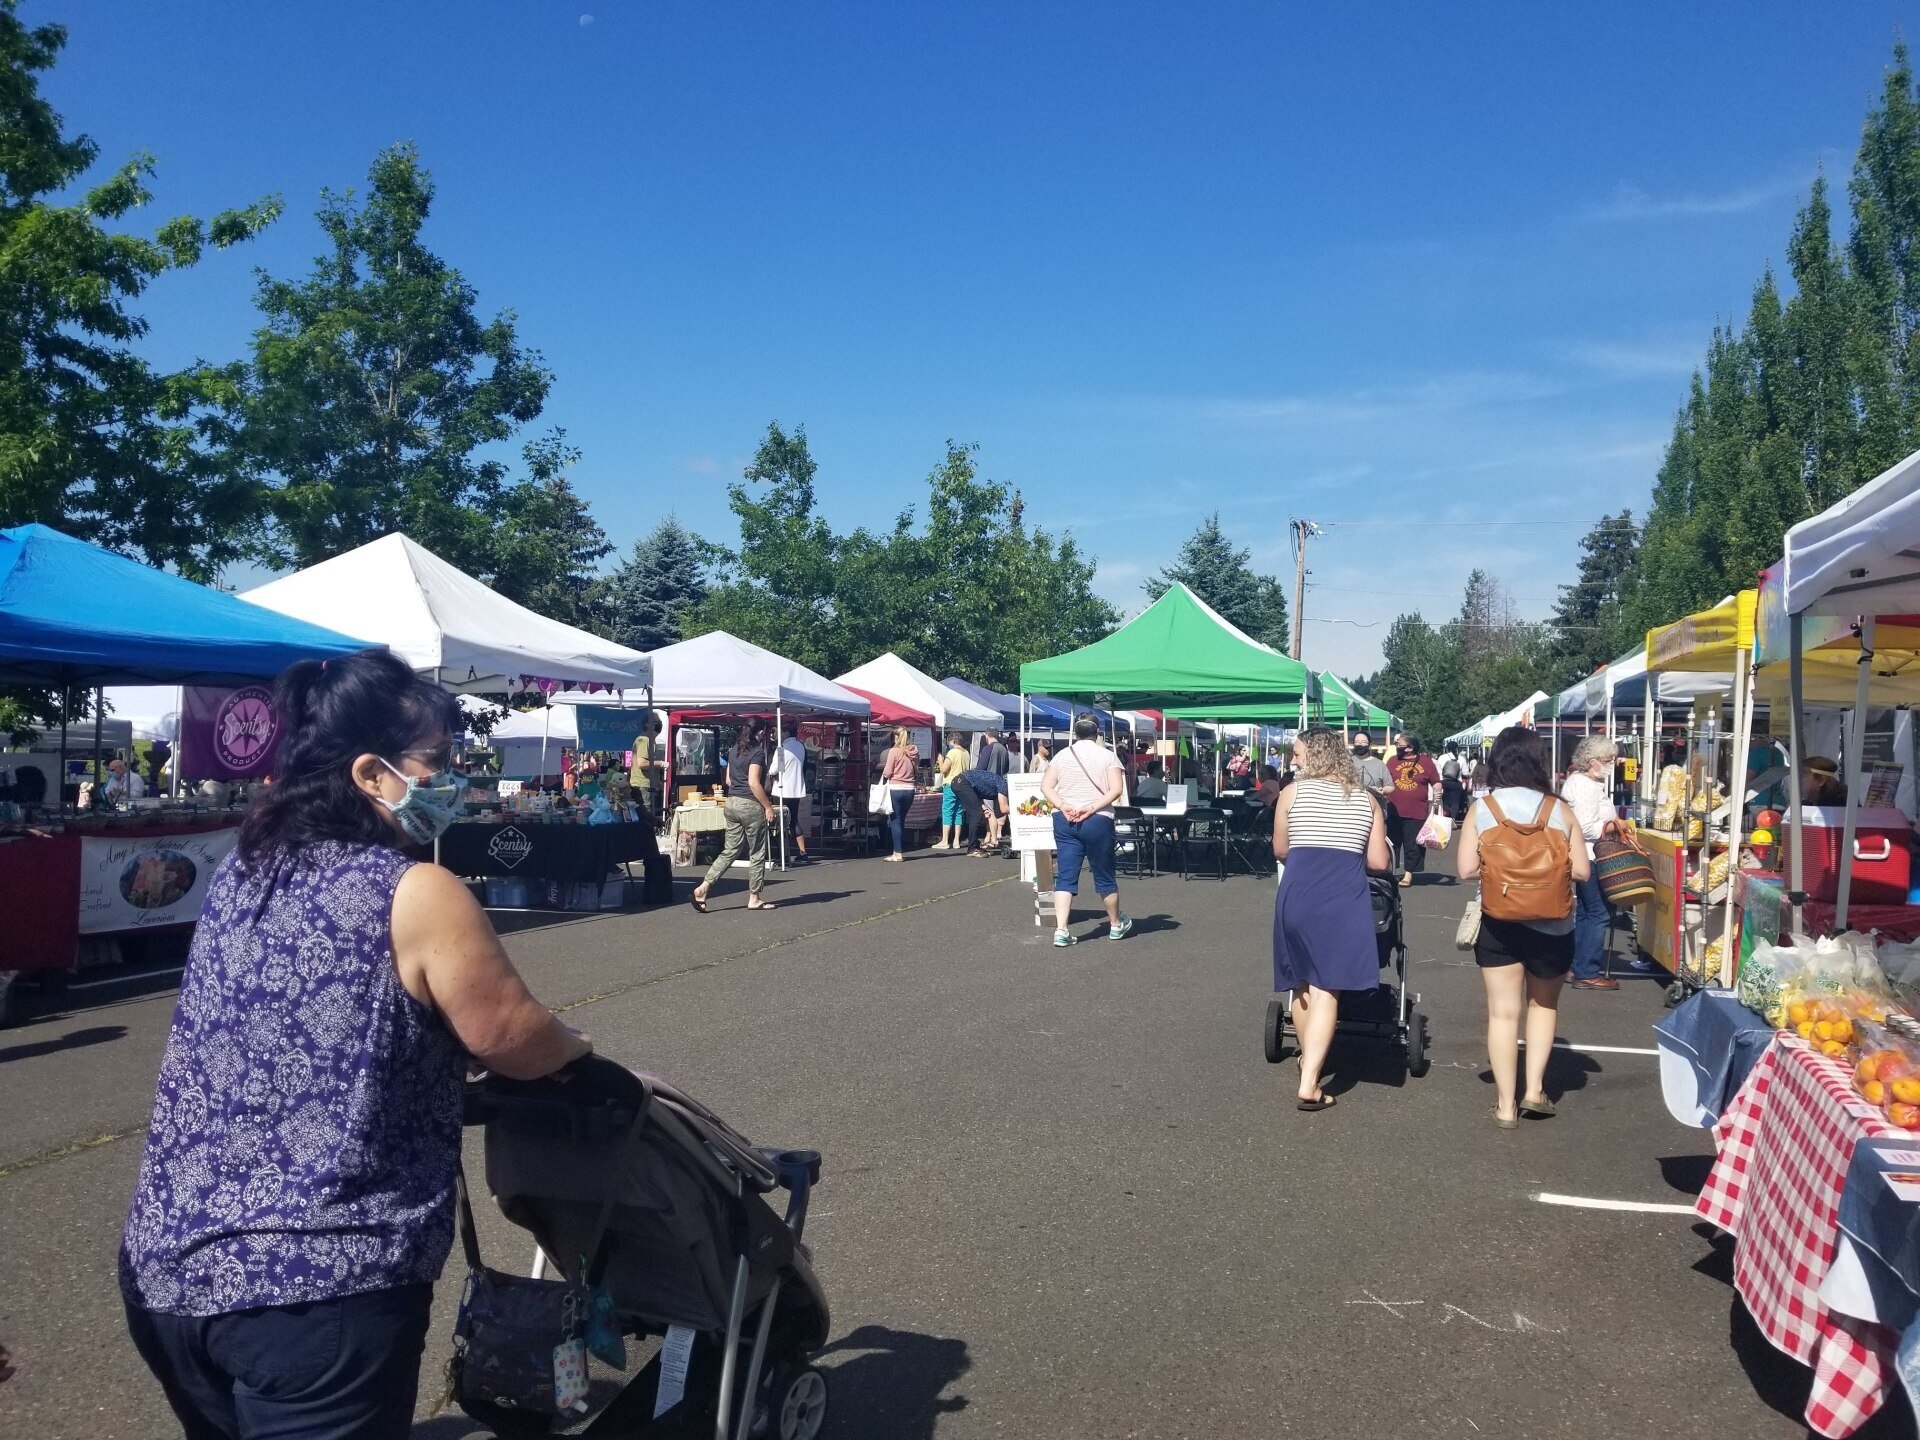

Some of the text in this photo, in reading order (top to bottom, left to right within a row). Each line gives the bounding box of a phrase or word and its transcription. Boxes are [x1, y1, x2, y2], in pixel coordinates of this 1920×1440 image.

[228, 691, 273, 710] AUTHENTIC
[221, 712, 271, 746] Scentsy
[222, 749, 261, 765] PRODUCT
[488, 836, 534, 857] Scentsy
